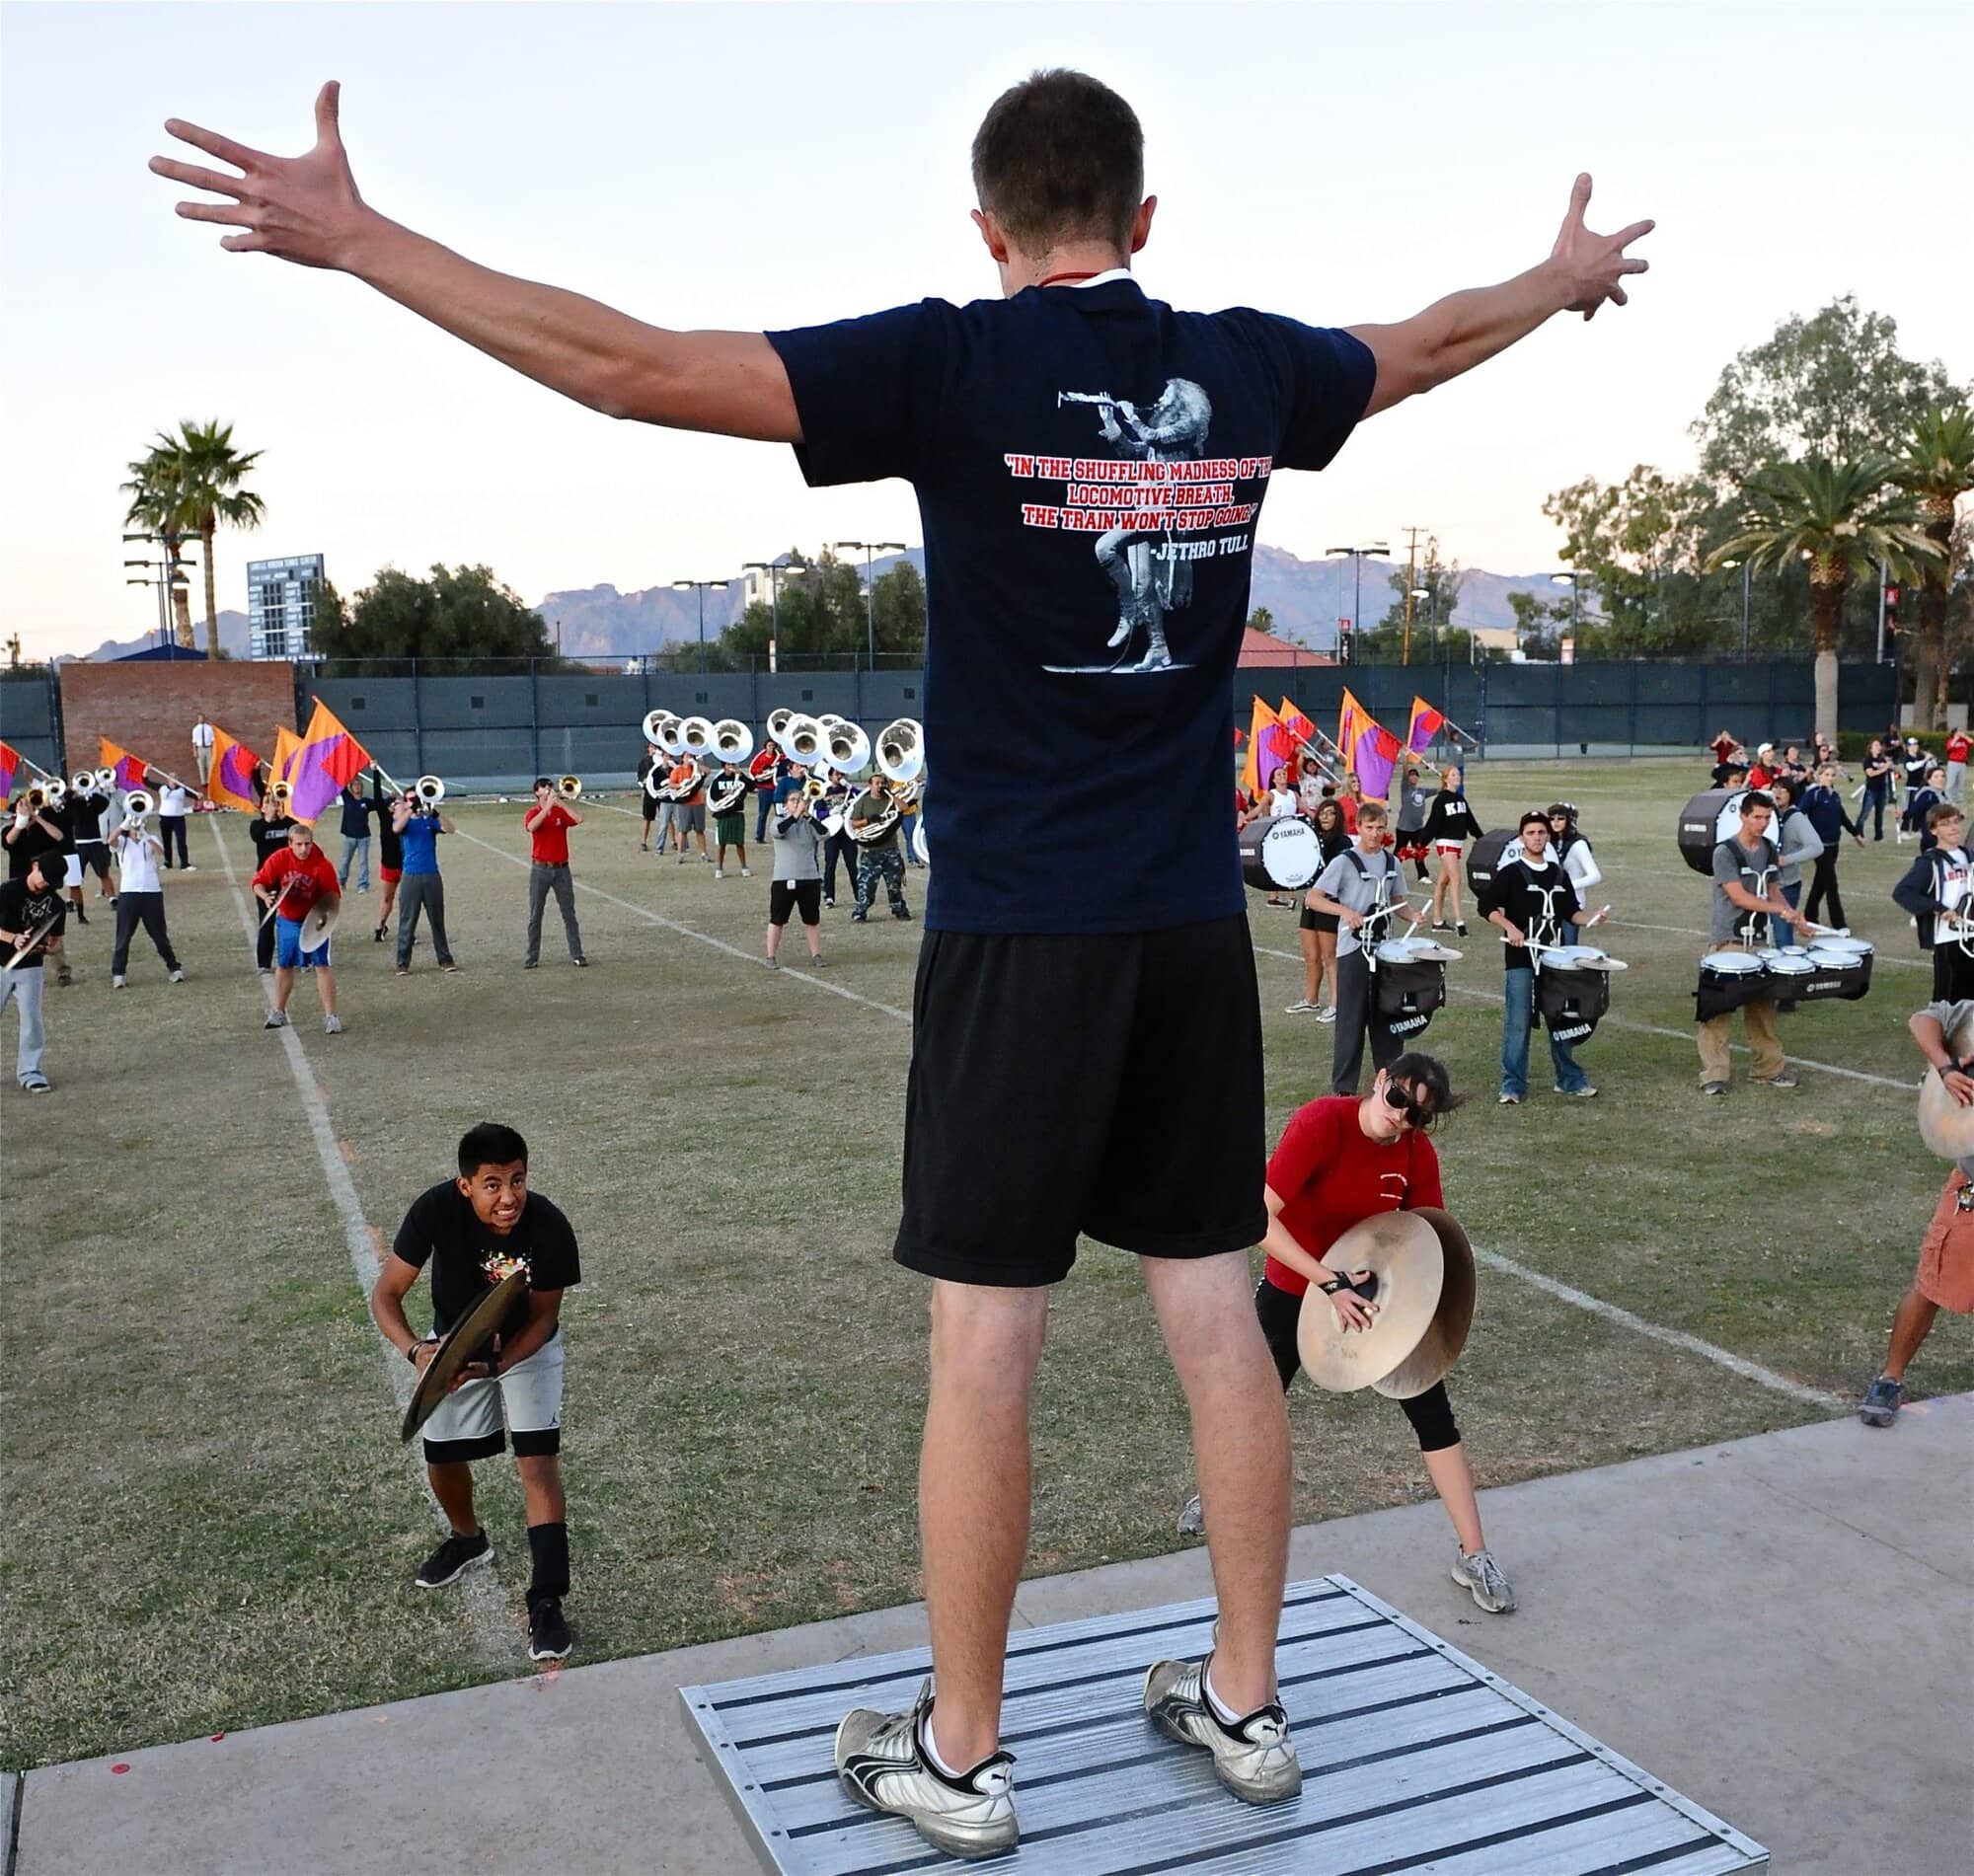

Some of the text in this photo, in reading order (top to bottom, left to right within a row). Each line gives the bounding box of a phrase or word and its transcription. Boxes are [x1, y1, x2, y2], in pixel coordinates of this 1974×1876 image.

[1004, 454, 1034, 478] "IN
[1036, 456, 1072, 480] THE
[1073, 458, 1167, 482] SHUFFLING
[1167, 459, 1239, 482] MADNESS
[1240, 458, 1257, 480] OF
[1067, 483, 1235, 507] LOCOMOTIVE BREATH,
[1022, 503, 1059, 528] THE
[1060, 507, 1117, 532] TRAIN
[1118, 509, 1176, 532] WON'T
[1177, 508, 1215, 531] STOP
[1150, 534, 1248, 561] -JETHRO TULL
[1280, 828, 1305, 839] YAMAHA
[1396, 1013, 1428, 1033] YAMAHA
[1558, 1022, 1592, 1041] YAMAHA
